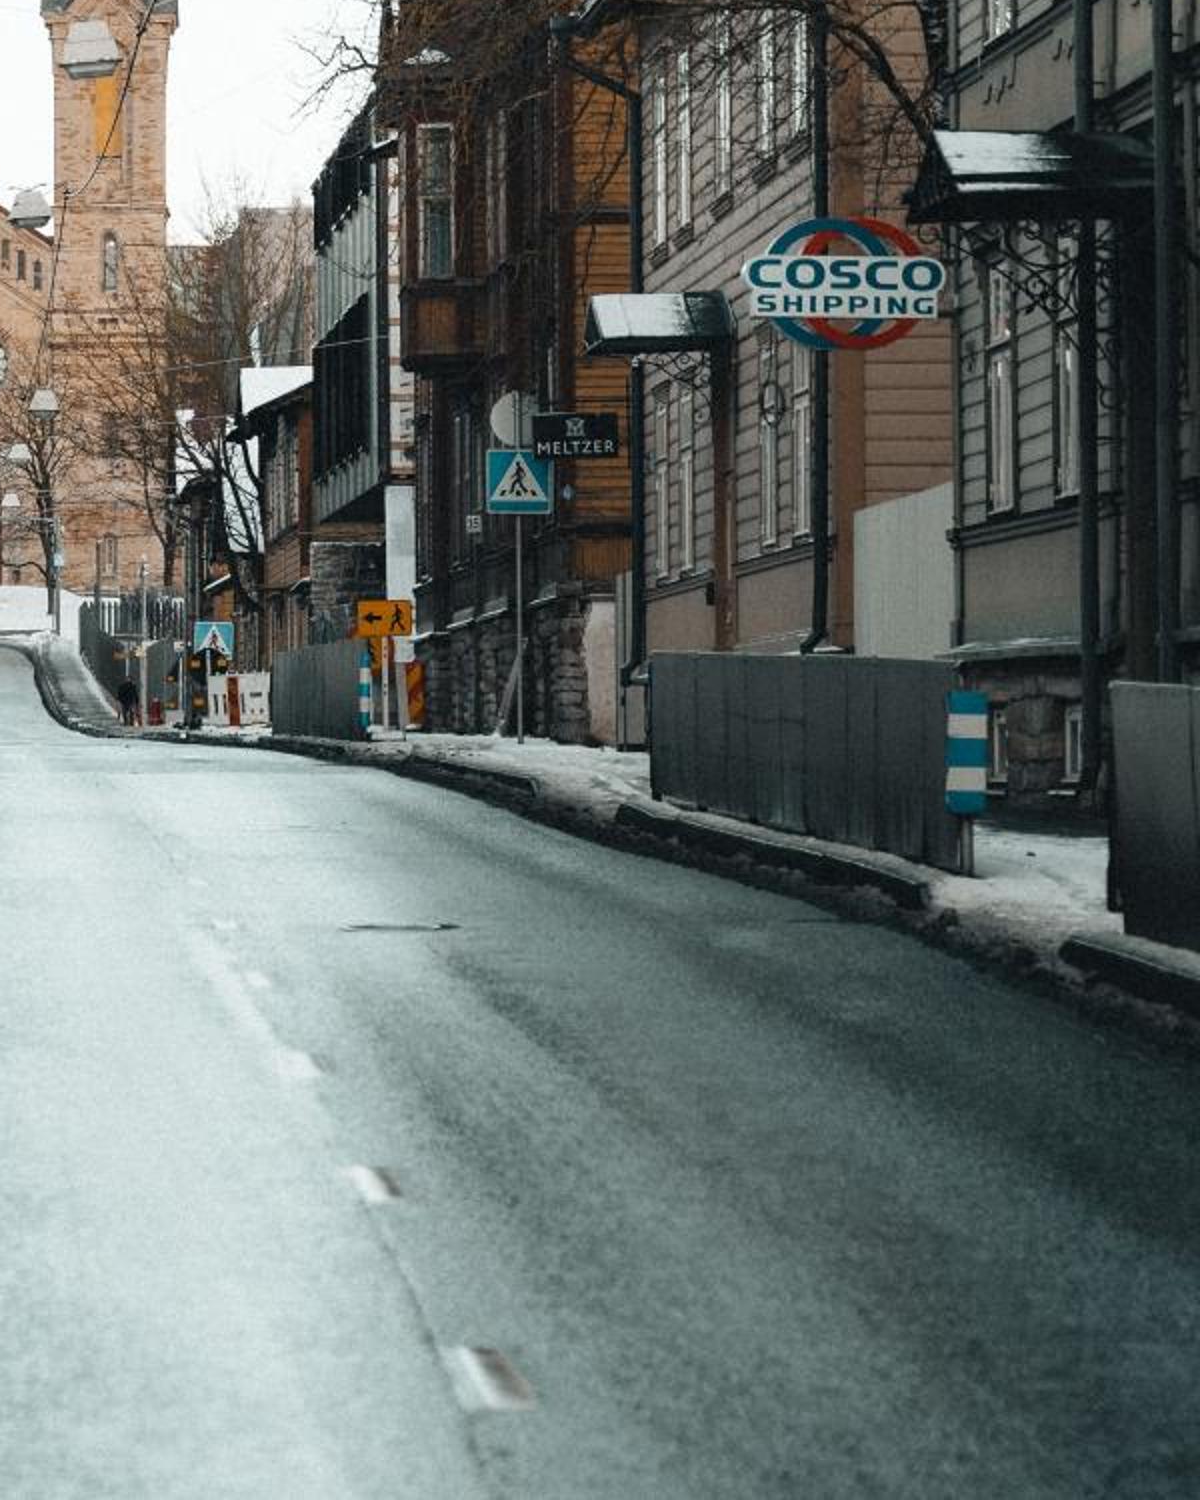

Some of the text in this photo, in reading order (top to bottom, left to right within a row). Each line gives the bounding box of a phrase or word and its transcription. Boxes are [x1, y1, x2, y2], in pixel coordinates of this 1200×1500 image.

[748, 258, 943, 291] COSCO
[757, 295, 935, 315] SHIPPING
[537, 440, 615, 455] MELTZER
